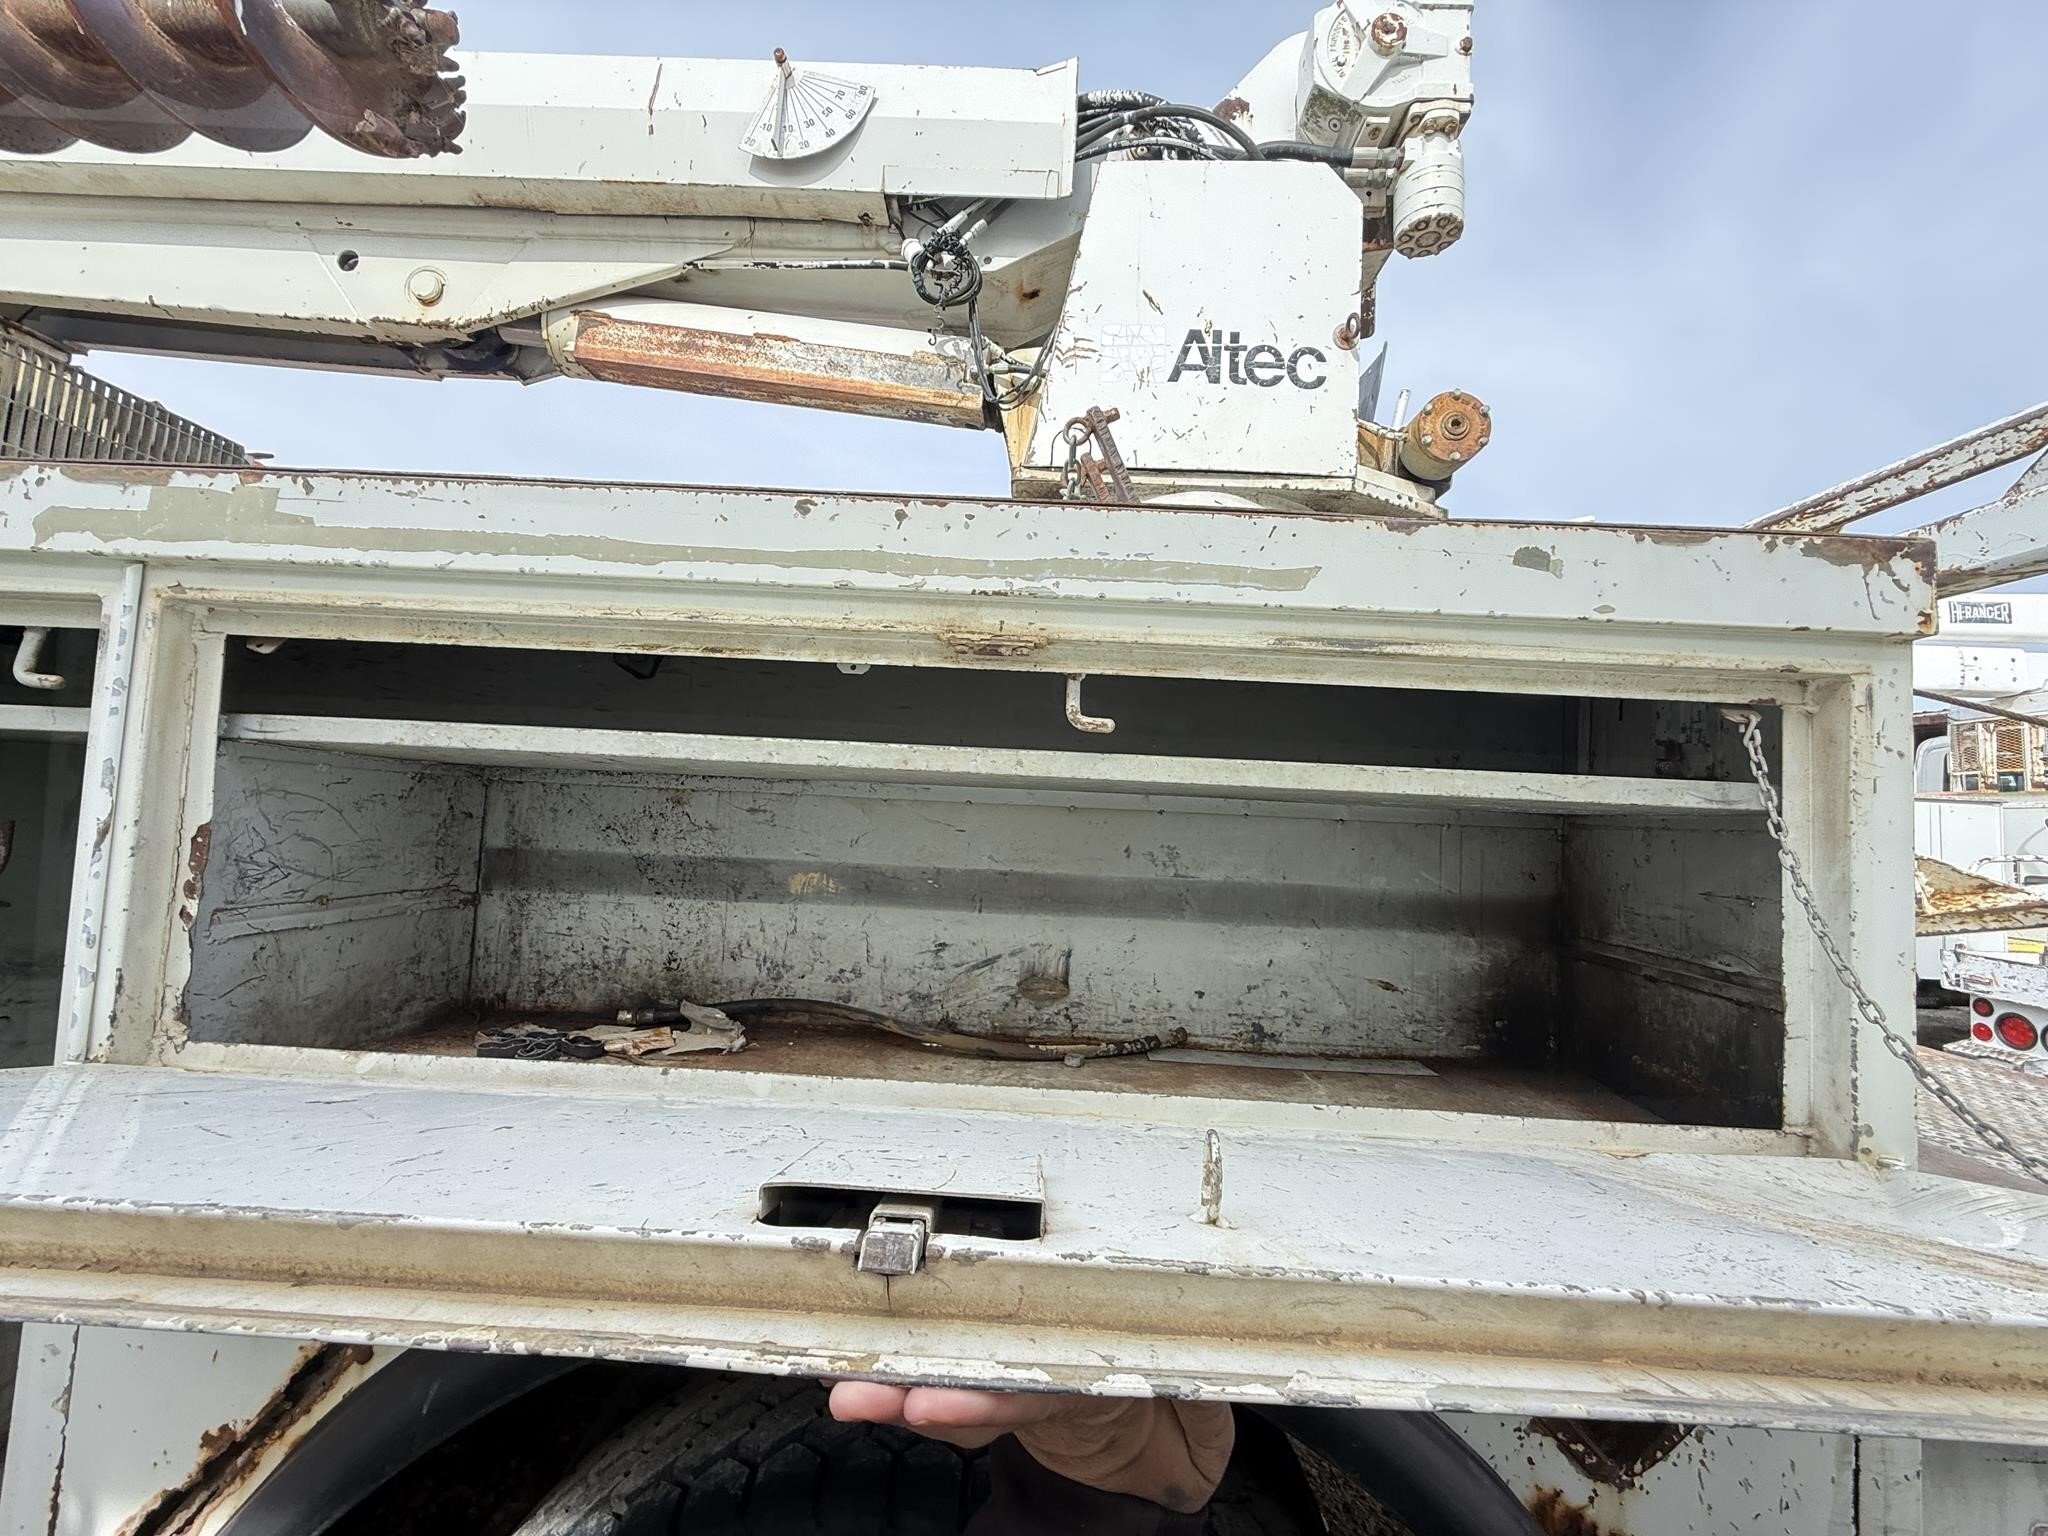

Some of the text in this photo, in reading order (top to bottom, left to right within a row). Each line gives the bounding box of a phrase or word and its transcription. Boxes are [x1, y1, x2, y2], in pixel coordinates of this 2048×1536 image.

[834, 90, 846, 100] 70
[857, 85, 868, 96] 80
[821, 106, 834, 118] 50
[845, 108, 857, 120] 60
[783, 124, 794, 133] 10
[803, 118, 815, 129] 30
[825, 128, 836, 138] 40
[798, 140, 810, 150] 20
[1167, 328, 1328, 390] Altec
